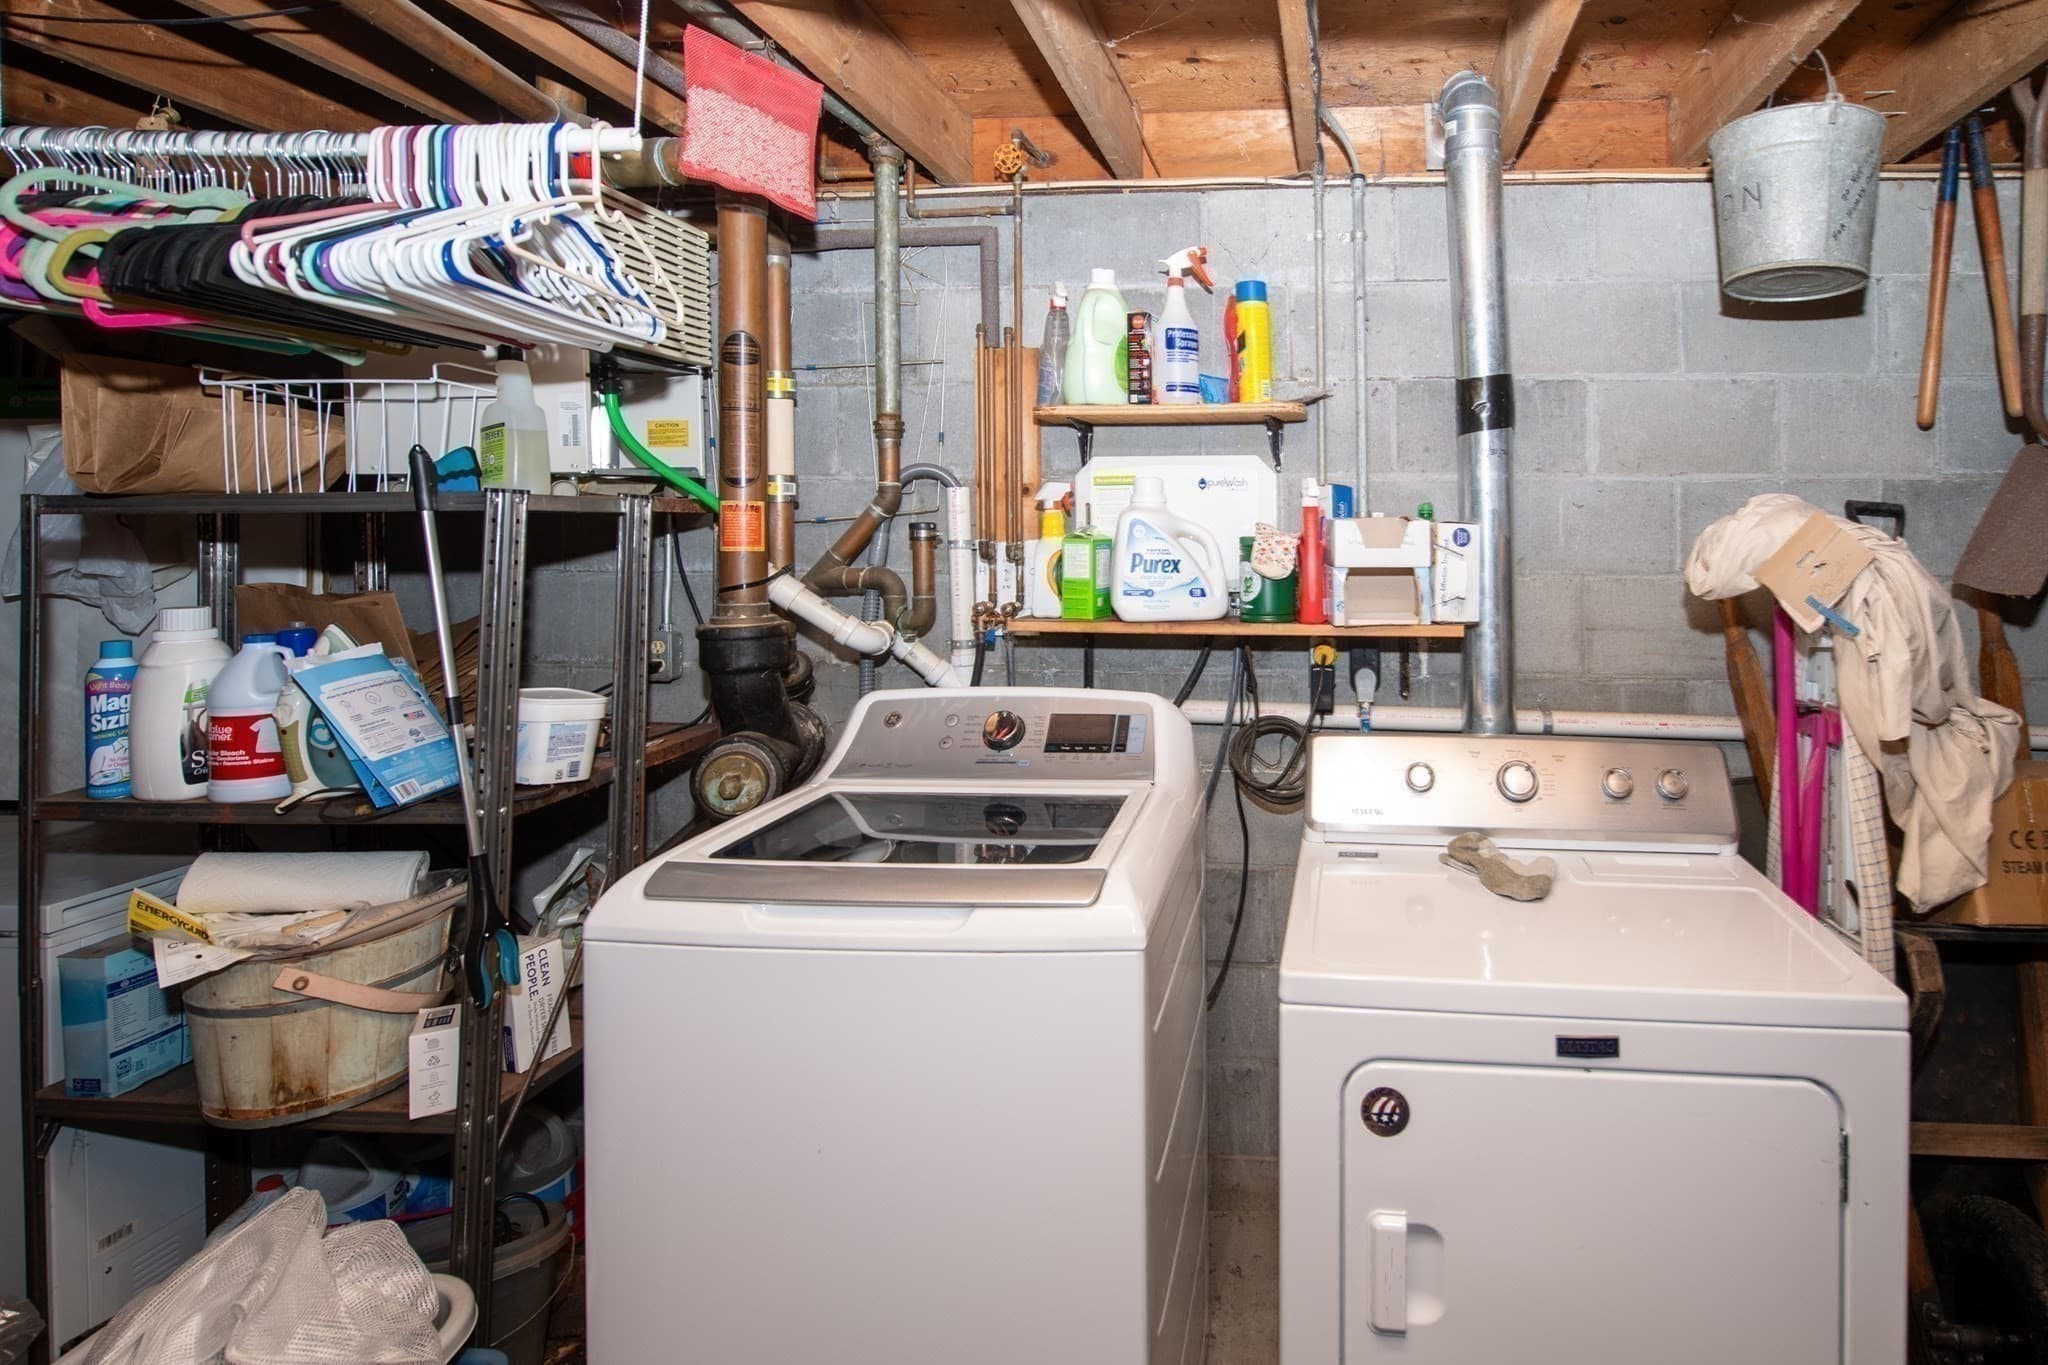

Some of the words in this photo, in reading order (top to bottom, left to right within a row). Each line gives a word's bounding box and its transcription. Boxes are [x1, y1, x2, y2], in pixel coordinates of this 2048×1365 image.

[1130, 553, 1182, 573] Purex
[90, 694, 132, 713] Mag
[220, 749, 246, 757] Bleach
[2001, 860, 2043, 874] STEAM
[136, 900, 213, 945] ENERGYGUID
[538, 948, 551, 987] CLEAN
